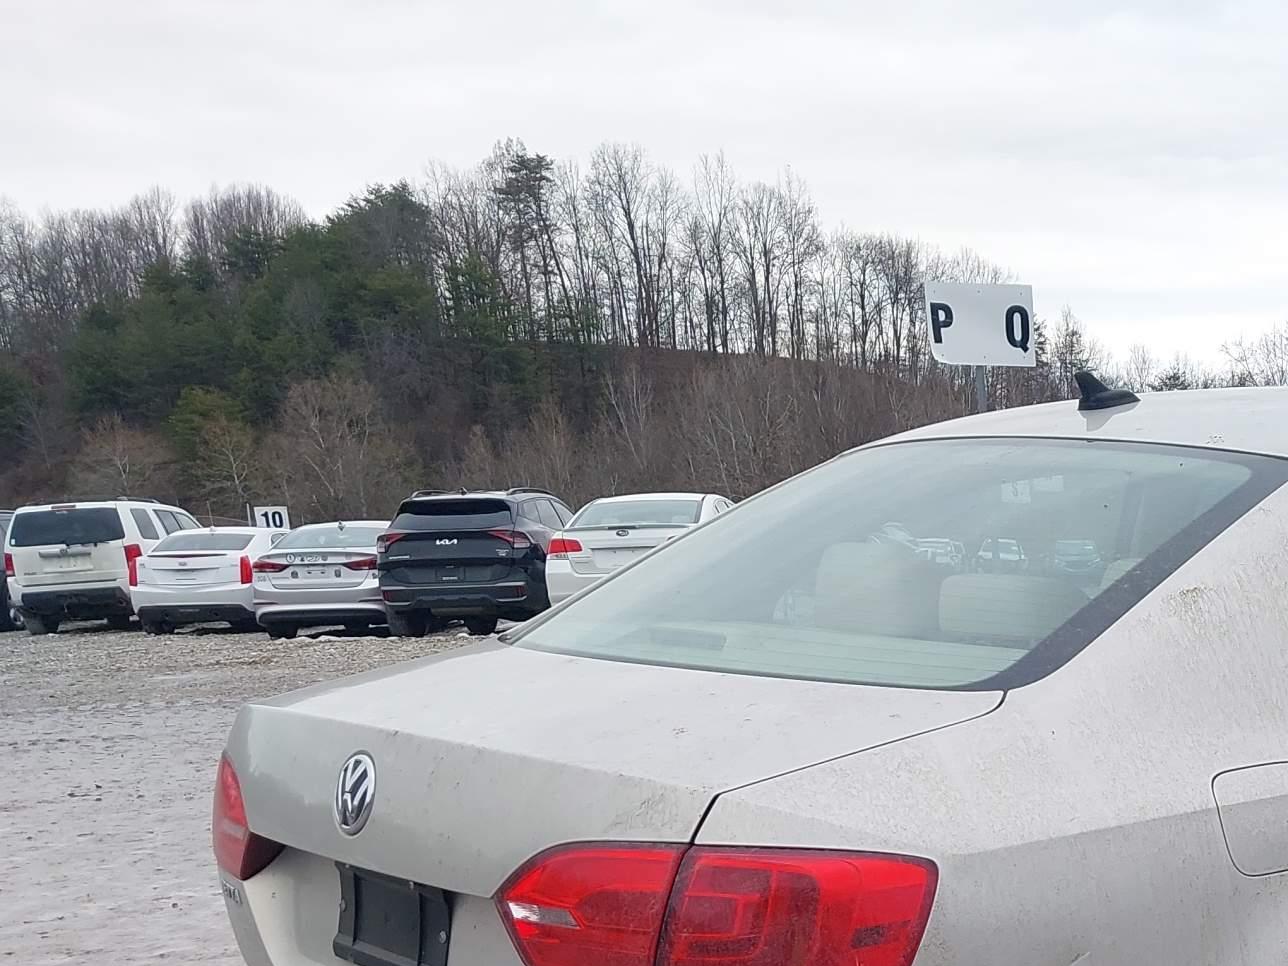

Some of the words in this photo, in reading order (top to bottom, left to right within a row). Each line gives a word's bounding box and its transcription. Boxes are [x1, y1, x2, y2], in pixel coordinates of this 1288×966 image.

[929, 301, 954, 344] P
[1005, 304, 1030, 354] Q
[260, 510, 284, 529] 10
